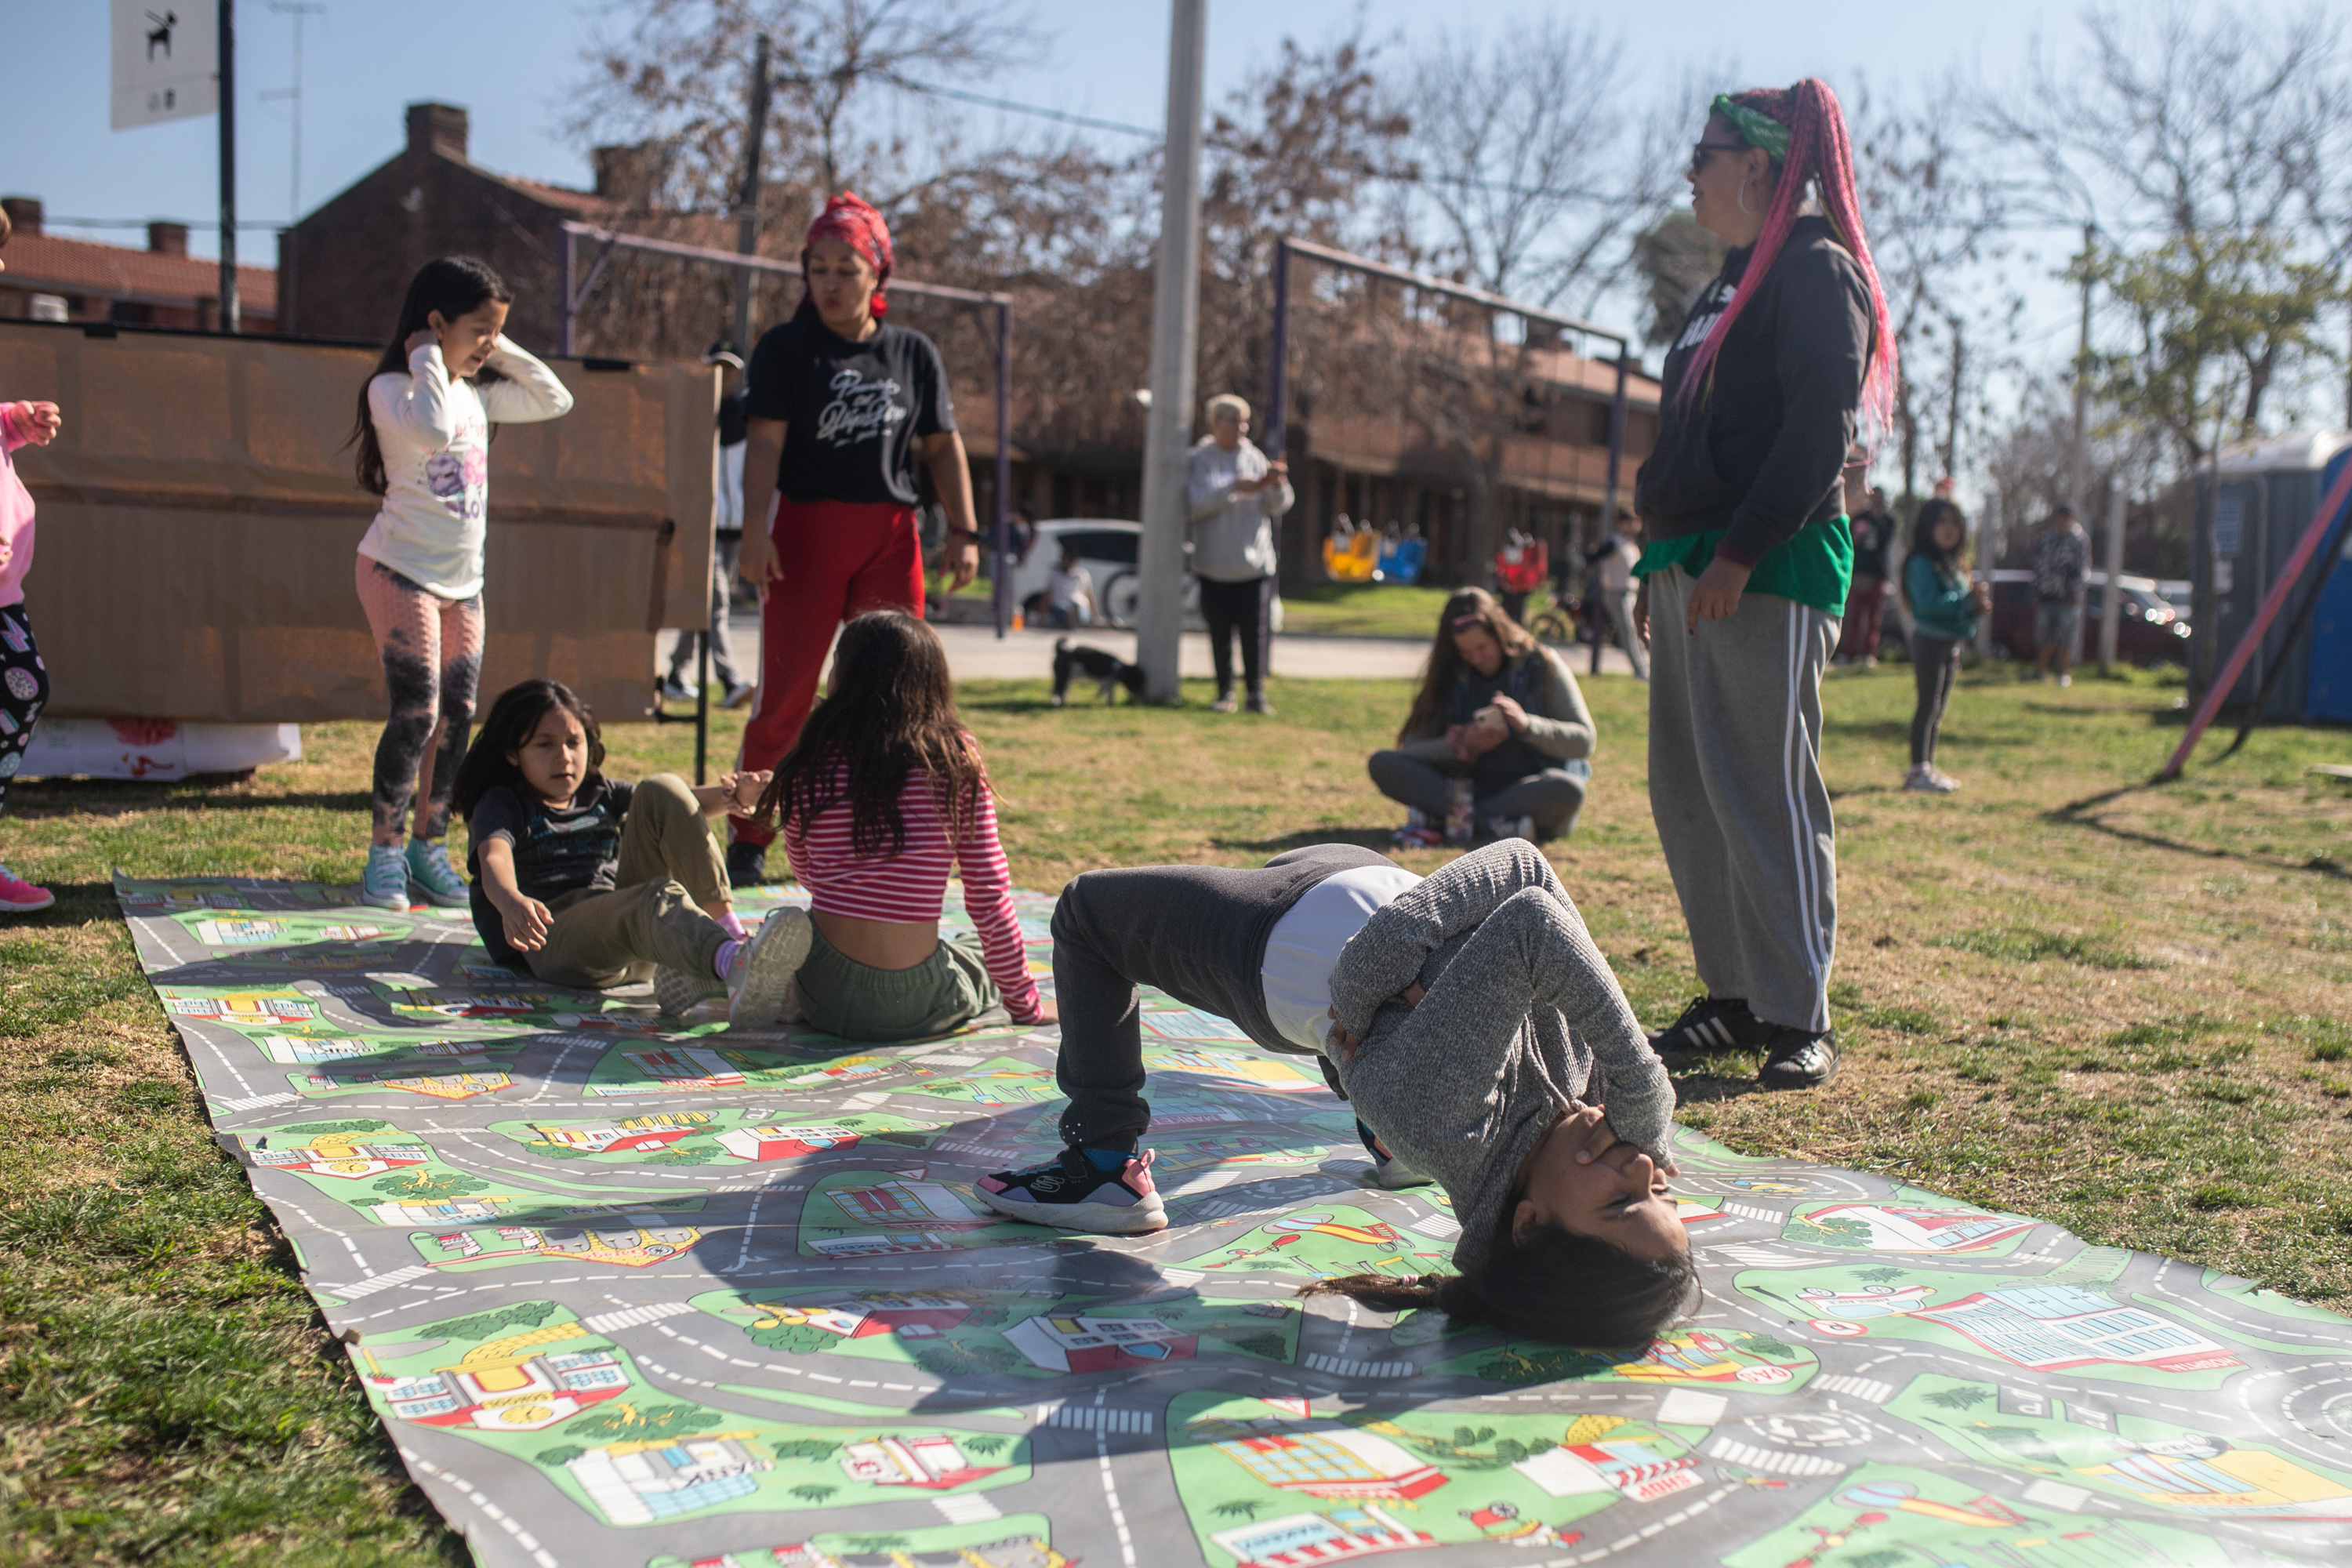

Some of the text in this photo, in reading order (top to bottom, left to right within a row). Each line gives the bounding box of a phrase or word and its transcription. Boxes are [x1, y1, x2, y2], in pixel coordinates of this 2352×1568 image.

[1153, 1115, 1220, 1125] MARKET
[1944, 1221, 1973, 1232] STATION
[827, 1243, 887, 1251] BAKERY
[2160, 1357, 2241, 1372] HOSPITAL
[1739, 1367, 1788, 1383] GAS
[2018, 1402, 2042, 1416] P
[2152, 1443, 2193, 1453] POLICE
[1639, 1474, 1690, 1498] SHOP
